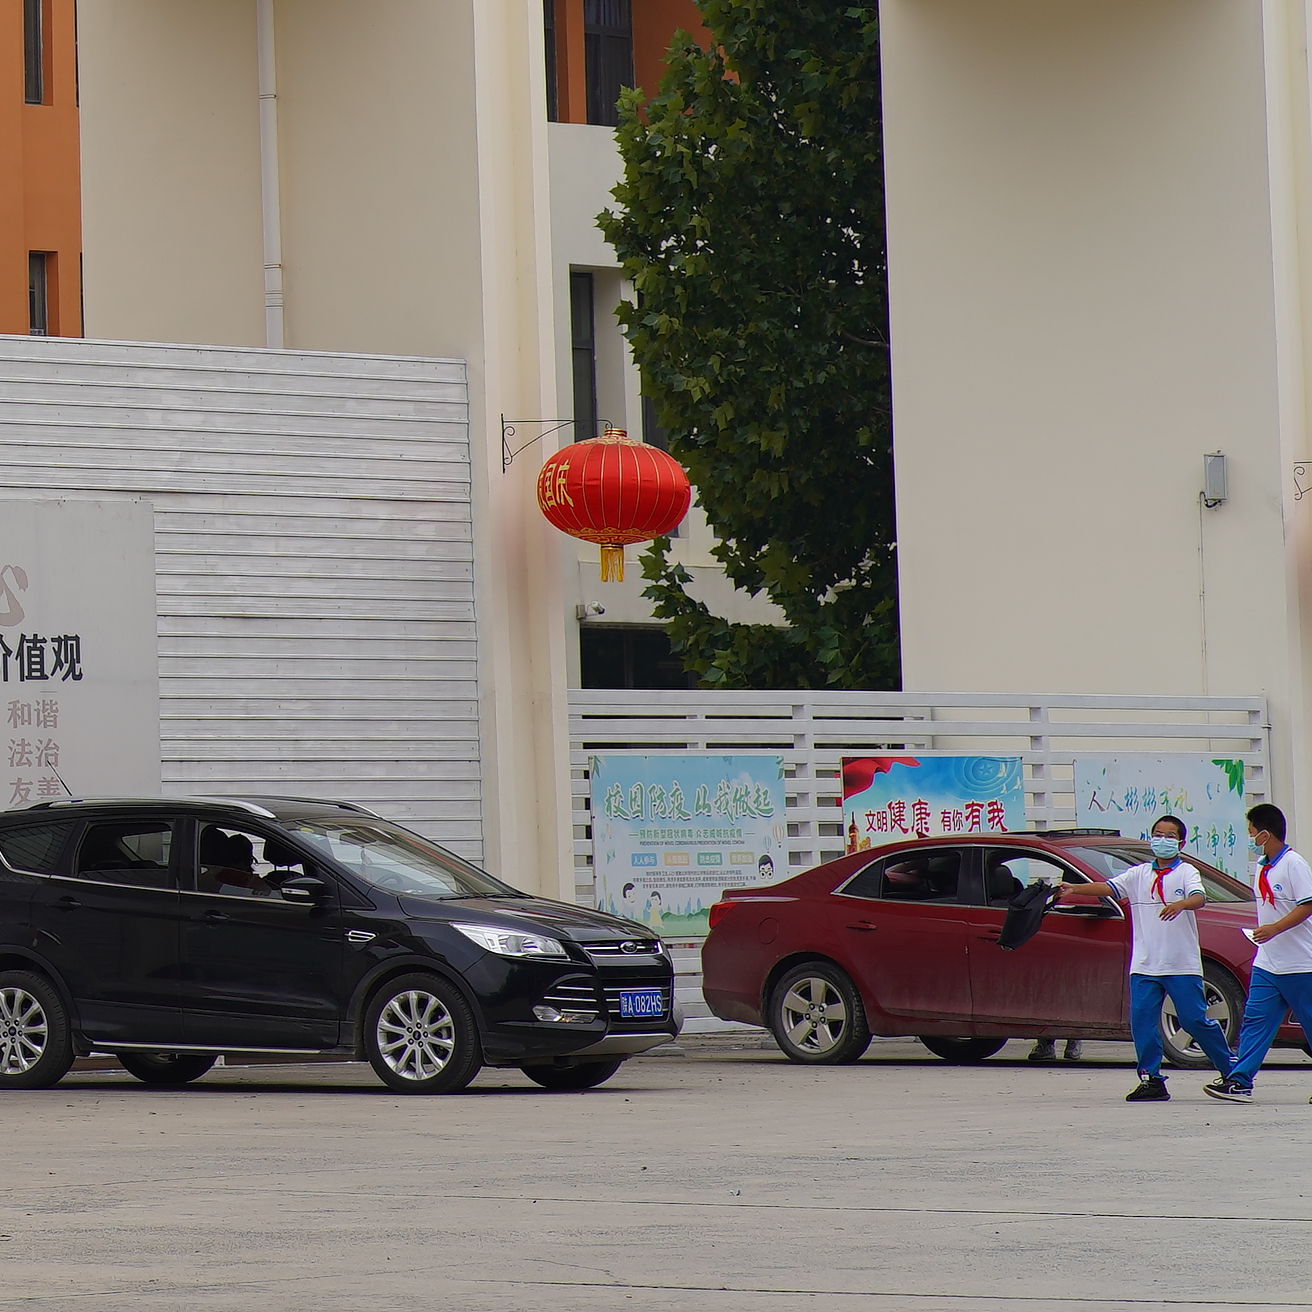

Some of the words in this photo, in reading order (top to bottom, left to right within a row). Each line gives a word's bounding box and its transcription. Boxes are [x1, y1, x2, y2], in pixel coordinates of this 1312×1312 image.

[7, 699, 59, 729] 和谐
[7, 738, 60, 768] 法治
[9, 776, 61, 806] 友善
[864, 798, 931, 834] 文明健康
[940, 799, 1009, 833] 有你有我
